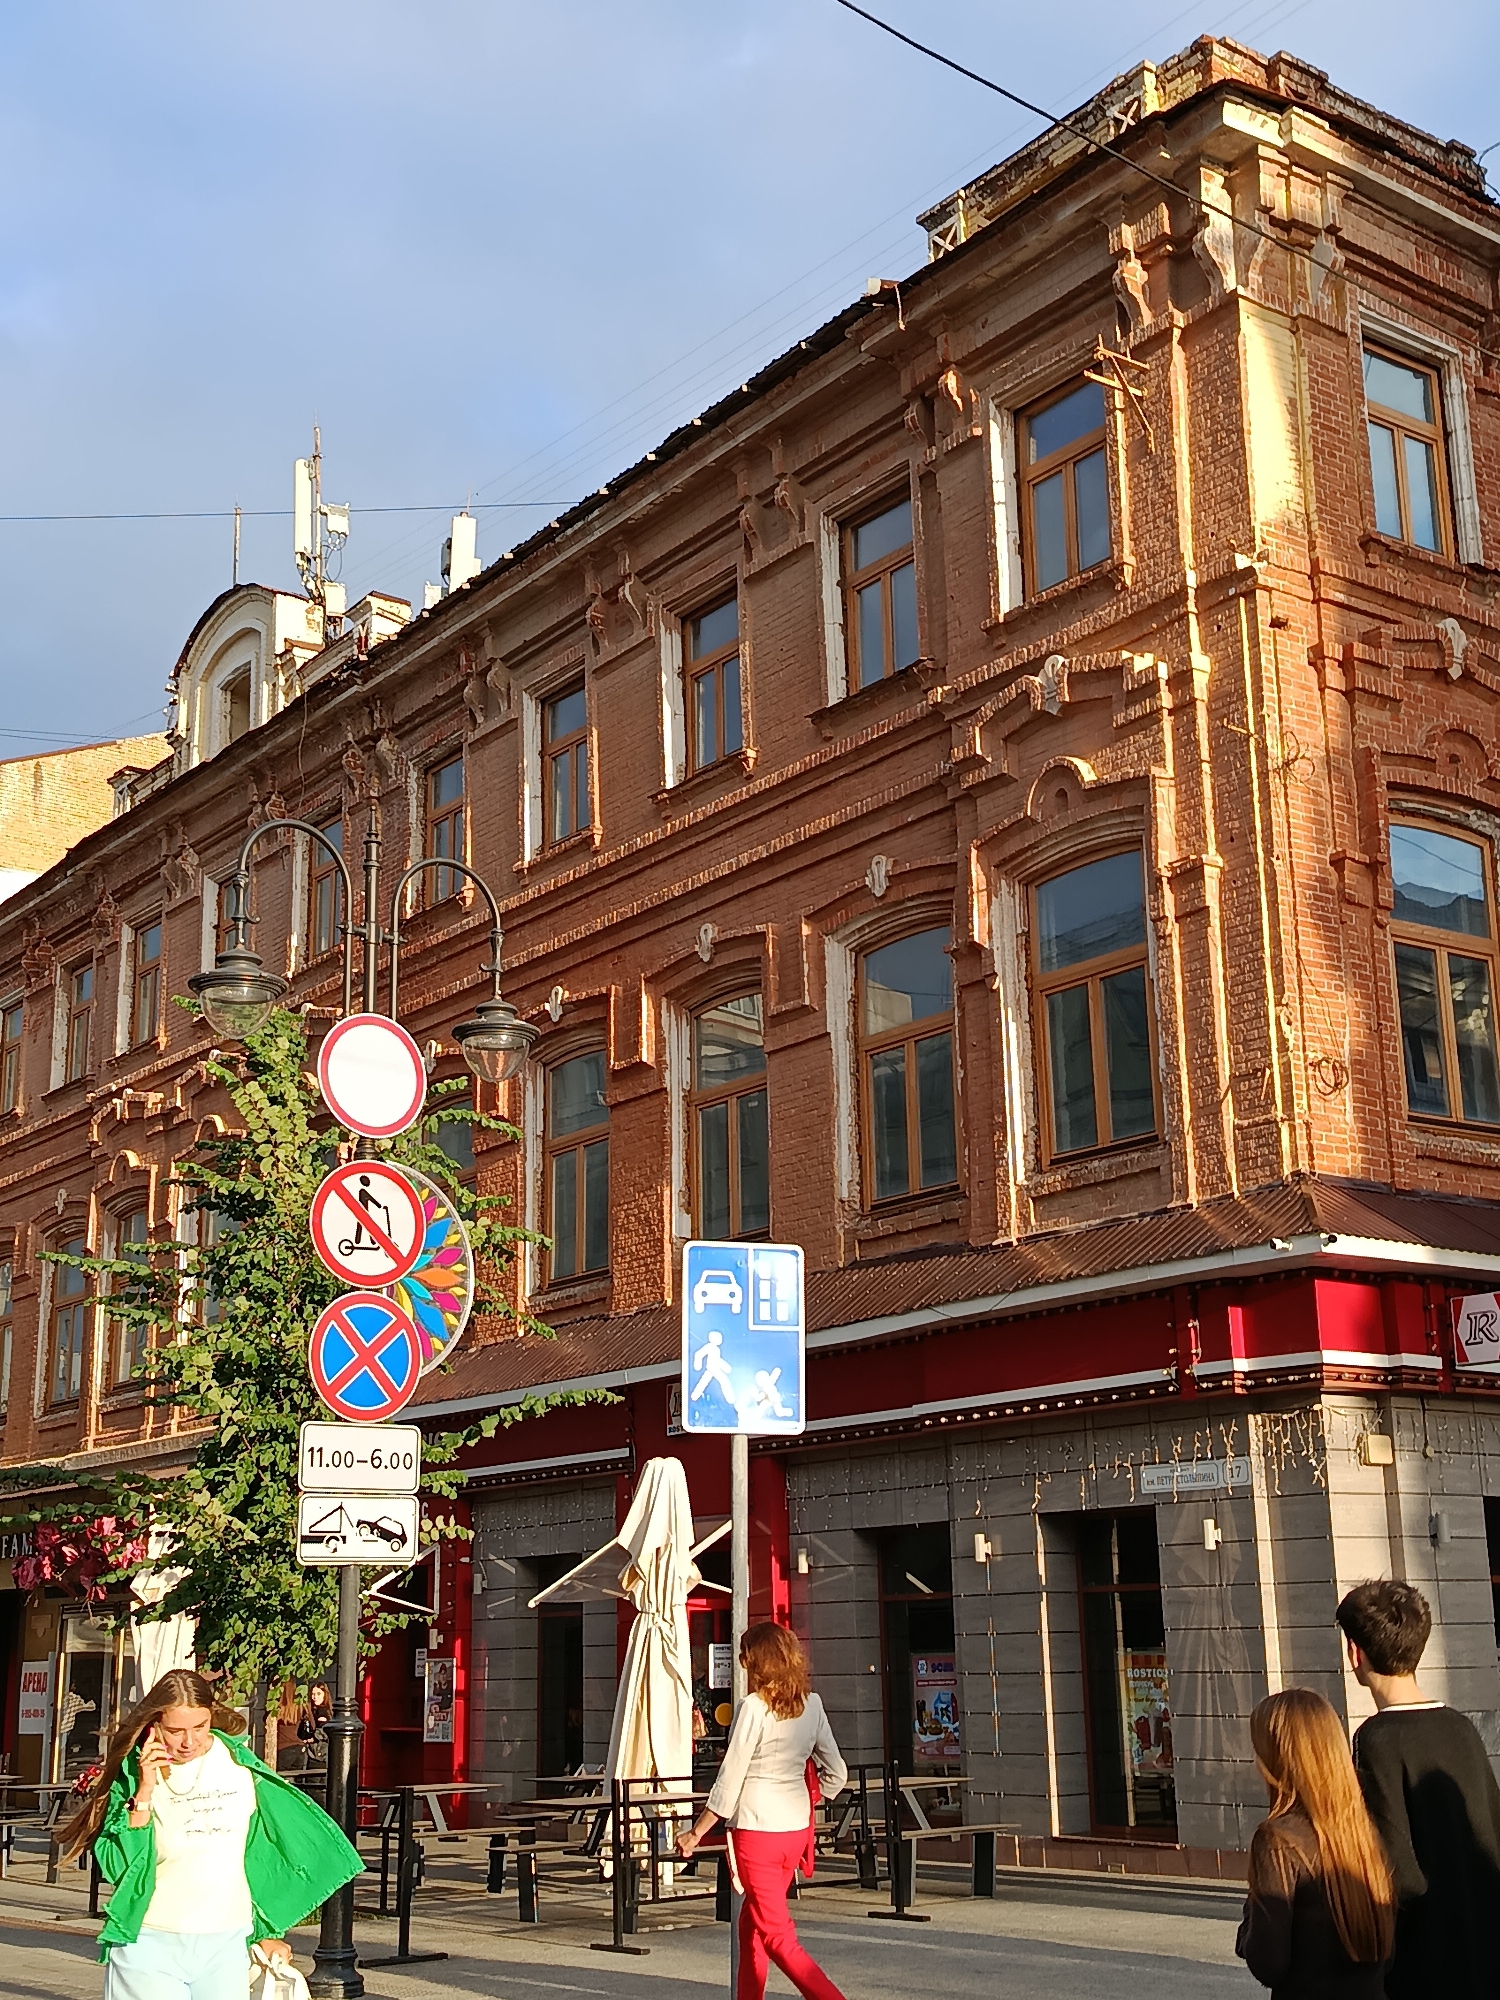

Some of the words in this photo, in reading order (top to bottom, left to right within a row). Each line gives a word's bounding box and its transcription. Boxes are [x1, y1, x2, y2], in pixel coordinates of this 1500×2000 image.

[1465, 1309, 1500, 1346] R
[307, 1446, 413, 1470] 11.00-6.00
[1156, 1474, 1174, 1486] ПЕТР
[1229, 1465, 1242, 1479] 17
[21, 1672, 48, 1696] АРЕНД
